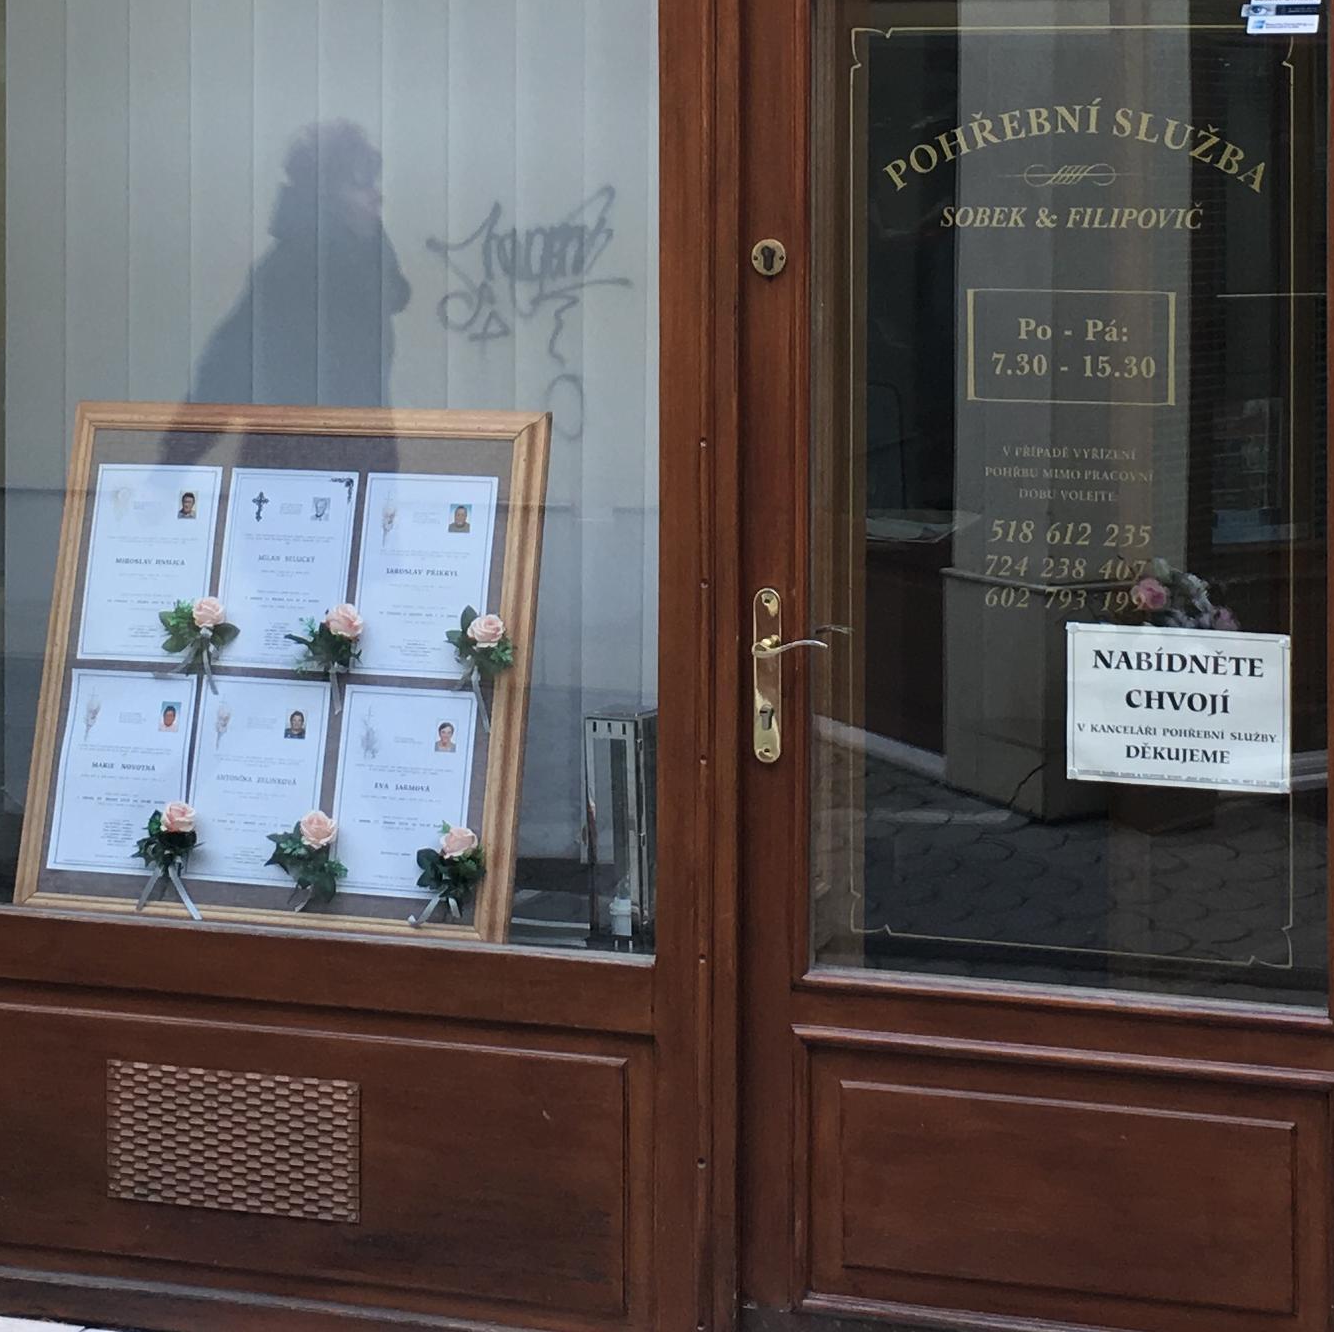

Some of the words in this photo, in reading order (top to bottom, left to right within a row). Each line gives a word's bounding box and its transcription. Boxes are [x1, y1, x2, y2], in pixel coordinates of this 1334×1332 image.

[882, 97, 1103, 192] POHŘEBNÍ
[1112, 106, 1267, 194] SLUŽBA
[940, 205, 1028, 228] SOBEK
[1036, 206, 1058, 228] &
[1066, 201, 1205, 230] FILIPOVIČ
[1018, 318, 1053, 341] Po
[1085, 319, 1129, 342] Pá:
[991, 352, 1048, 375] 7.30
[1083, 355, 1156, 379] 15.30
[1002, 445, 1011, 457] V
[1073, 447, 1137, 461] VYŘÍZENÍ
[985, 465, 1039, 478] POHŘBU
[1042, 467, 1081, 480] MIMO
[1084, 468, 1154, 482] PRACOVNÍ
[1019, 488, 1055, 500] DOBU
[988, 519, 1035, 544] 518
[1046, 522, 1092, 545] 612
[1103, 523, 1153, 548] 235
[985, 554, 1029, 577] 724
[1040, 557, 1088, 579] 238
[985, 586, 1030, 608] 602
[1045, 588, 1088, 610] 793
[1092, 647, 1265, 678] NABÍDNĚTE
[1125, 688, 1230, 716] CHVOJÍ
[1077, 722, 1085, 733] V
[1090, 723, 1158, 737] KANCELÁŘI
[1162, 728, 1225, 740] POHŘEBNÍ
[1125, 742, 1231, 765] DĚKUJEME
